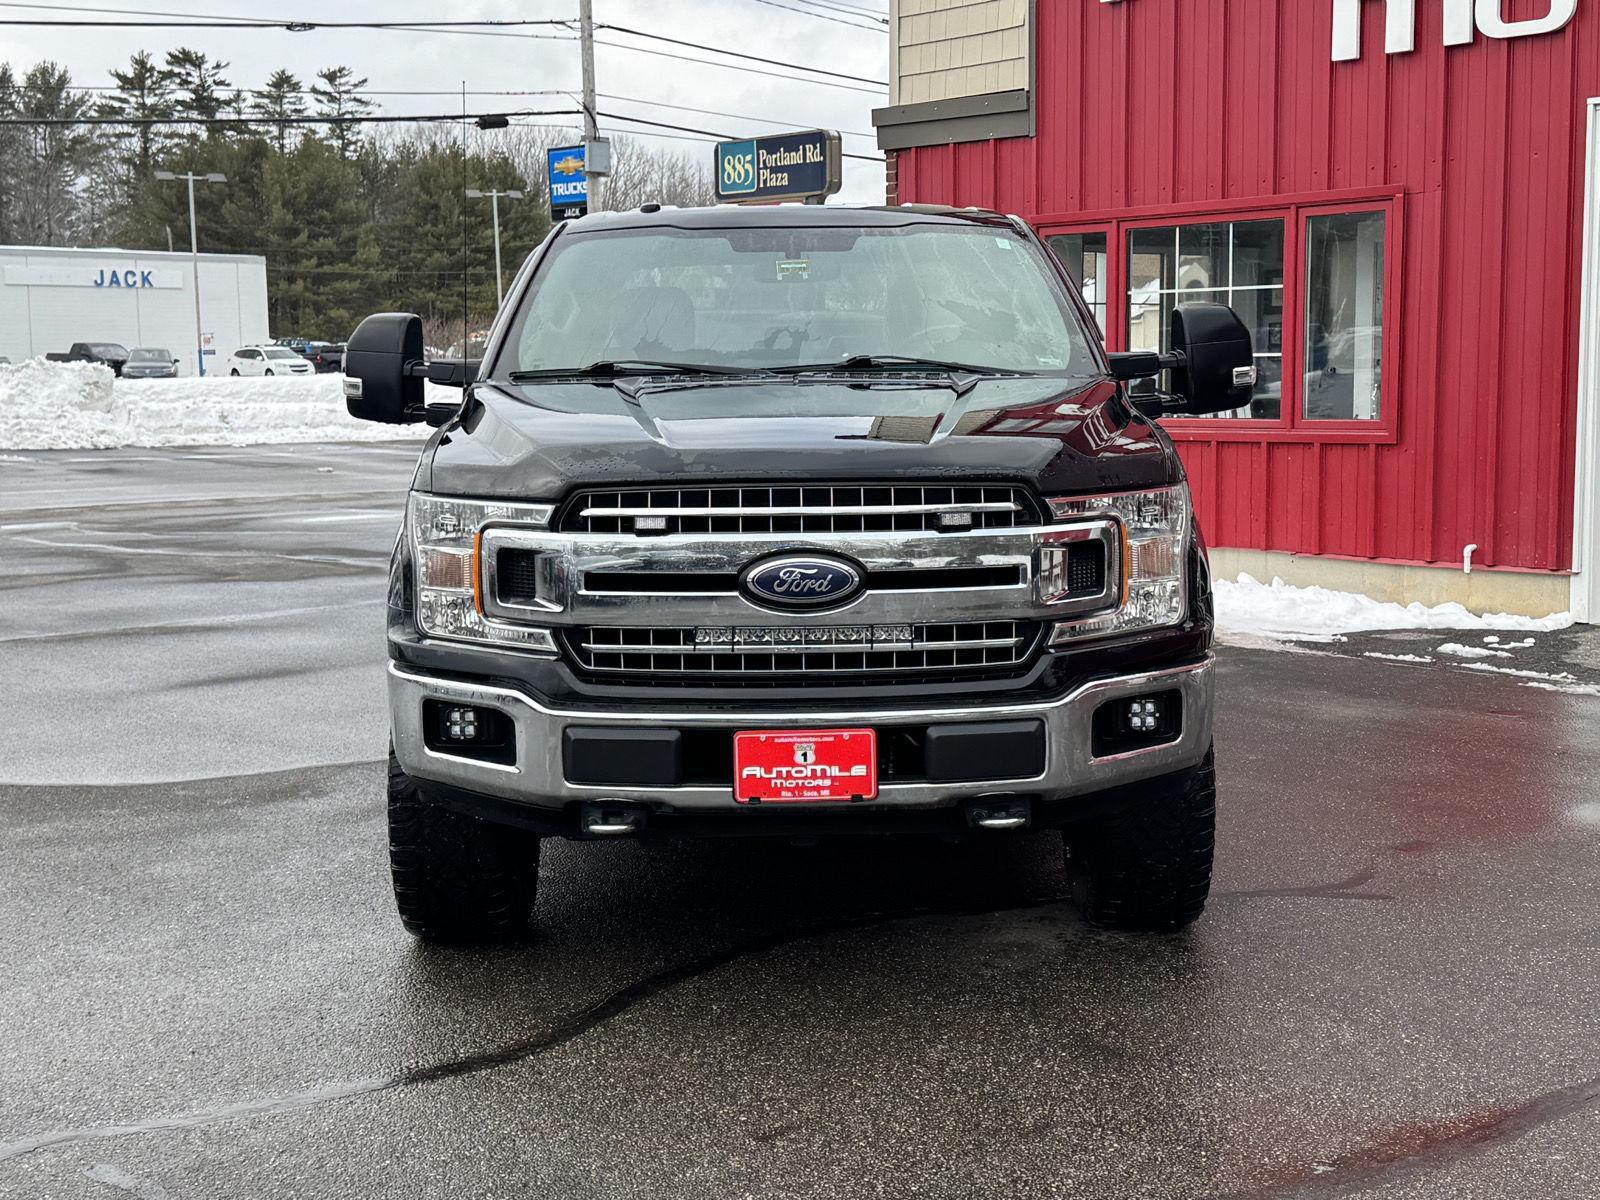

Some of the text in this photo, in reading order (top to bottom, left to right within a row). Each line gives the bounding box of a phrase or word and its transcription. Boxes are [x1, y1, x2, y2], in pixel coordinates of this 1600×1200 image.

[758, 143, 824, 168] Portland Rd.
[723, 153, 754, 186] 885
[759, 169, 789, 188] Plaza
[551, 181, 588, 196] TRUCKS
[563, 208, 581, 217] JACK
[94, 269, 154, 288] JACK
[773, 567, 833, 593] Ford
[801, 751, 808, 763] 1
[742, 765, 867, 779] AUTOMILE
[771, 779, 832, 788] MOTORS
